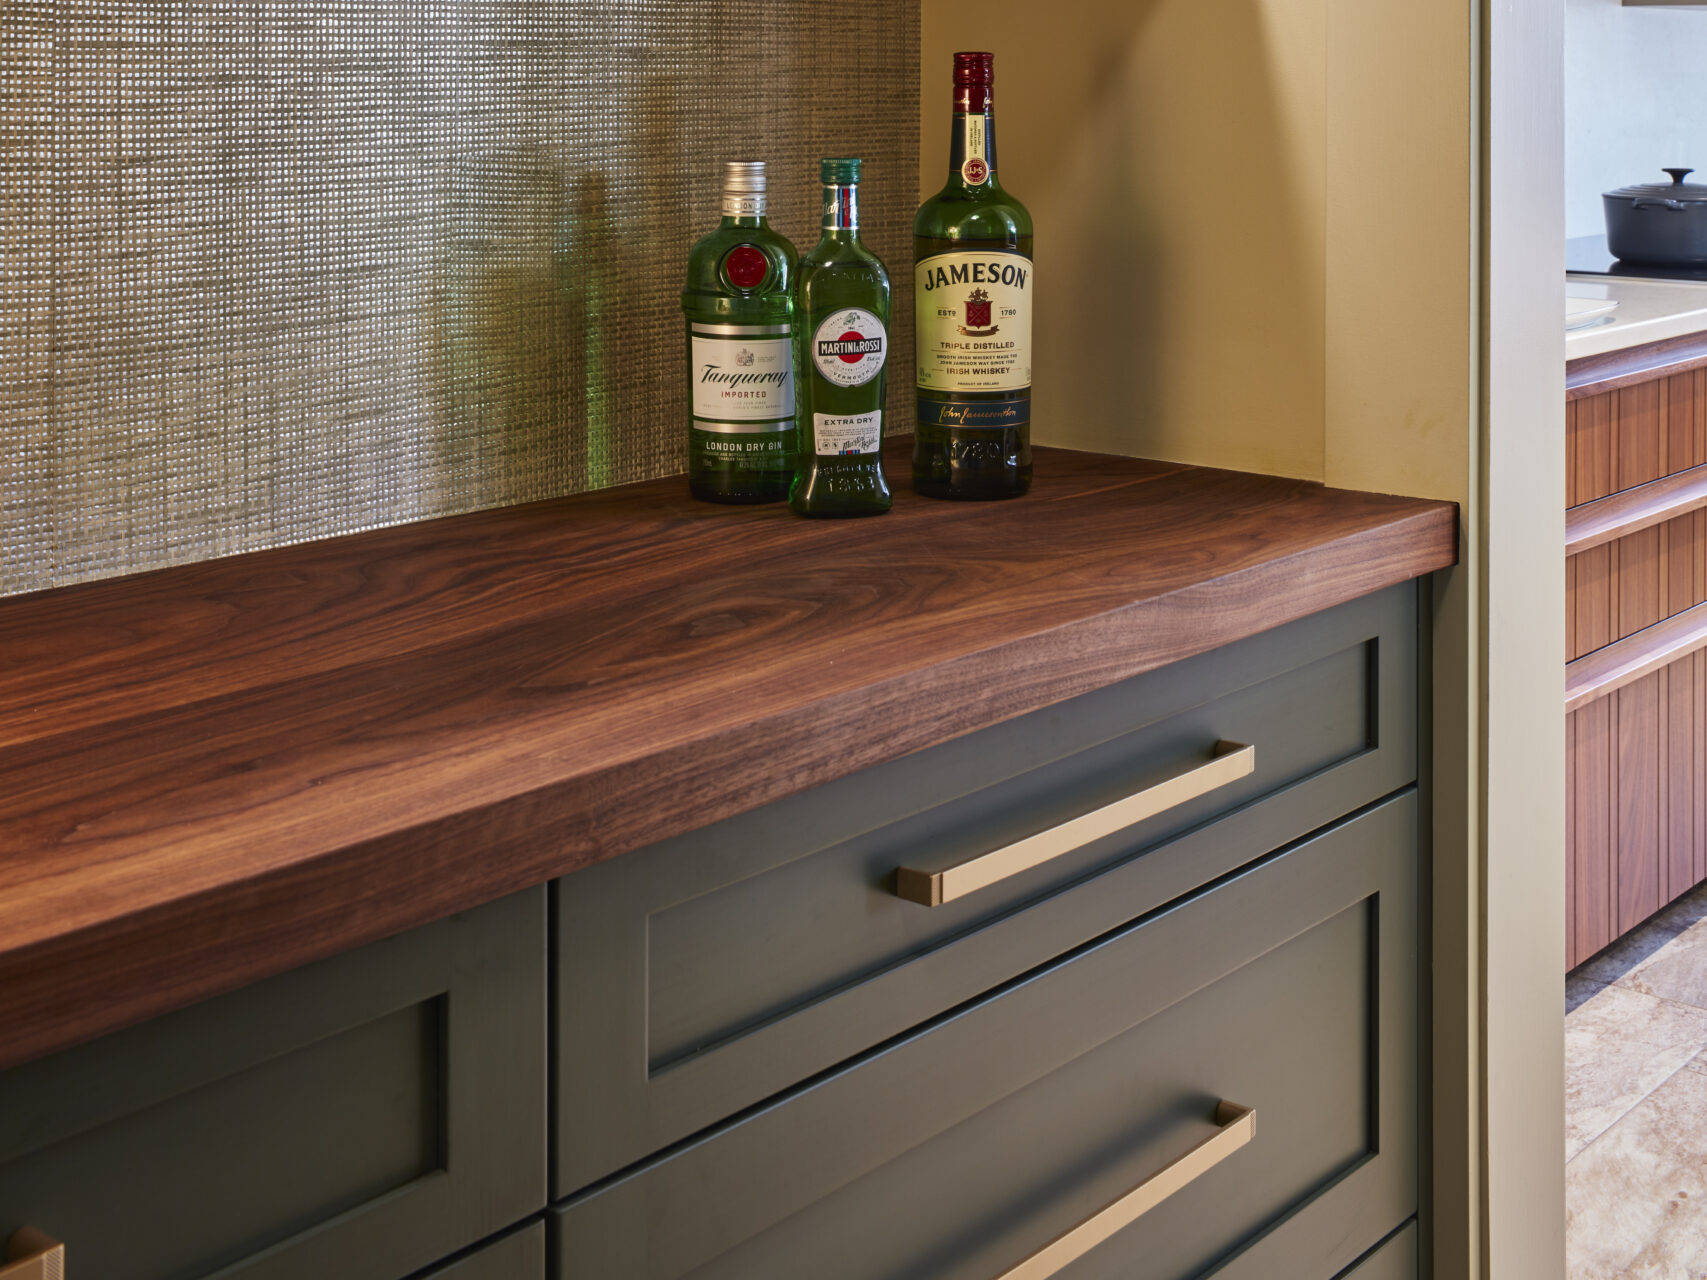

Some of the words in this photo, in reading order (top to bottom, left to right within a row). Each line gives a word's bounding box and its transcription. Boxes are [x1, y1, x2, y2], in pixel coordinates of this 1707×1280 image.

[925, 263, 1027, 291] JAMESON
[940, 342, 971, 350] TRIPLE
[973, 341, 1015, 350] DISTILLED
[946, 367, 970, 375] IRISH
[972, 366, 1011, 375] WHISKEY
[701, 364, 788, 389] Tanqueray
[721, 391, 767, 399] IMPORTED
[706, 441, 742, 451] LONDON
[746, 442, 765, 452] DRY
[768, 441, 782, 450] GIN
